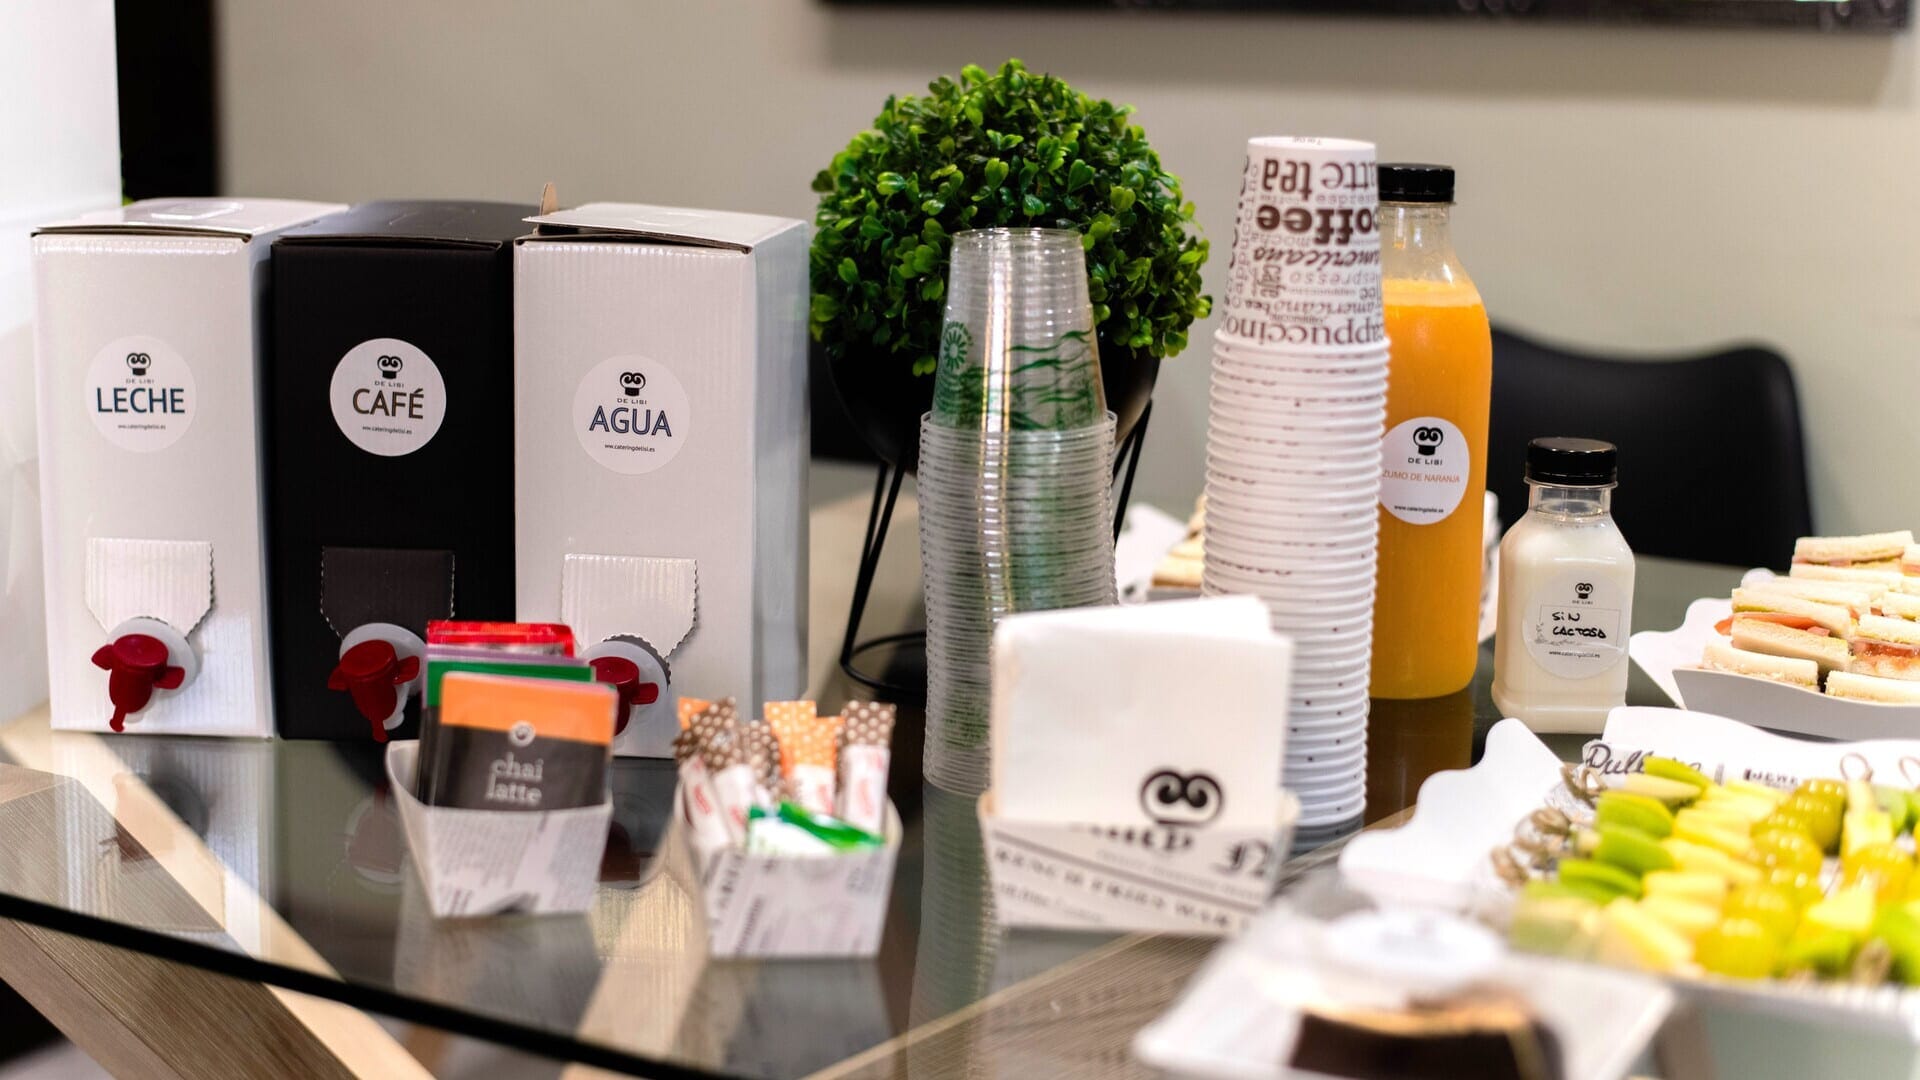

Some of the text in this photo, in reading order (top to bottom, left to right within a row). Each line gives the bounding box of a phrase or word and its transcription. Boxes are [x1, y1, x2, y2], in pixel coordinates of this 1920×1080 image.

[1262, 158, 1313, 201] tea
[1225, 316, 1384, 346] appuccino
[96, 386, 186, 414] LECHE
[352, 387, 425, 420] CAFÉ
[588, 404, 673, 438] AGUA
[1382, 469, 1460, 483] ZUMO DE NARANJA
[489, 751, 545, 782] chai
[484, 773, 543, 806] latte
